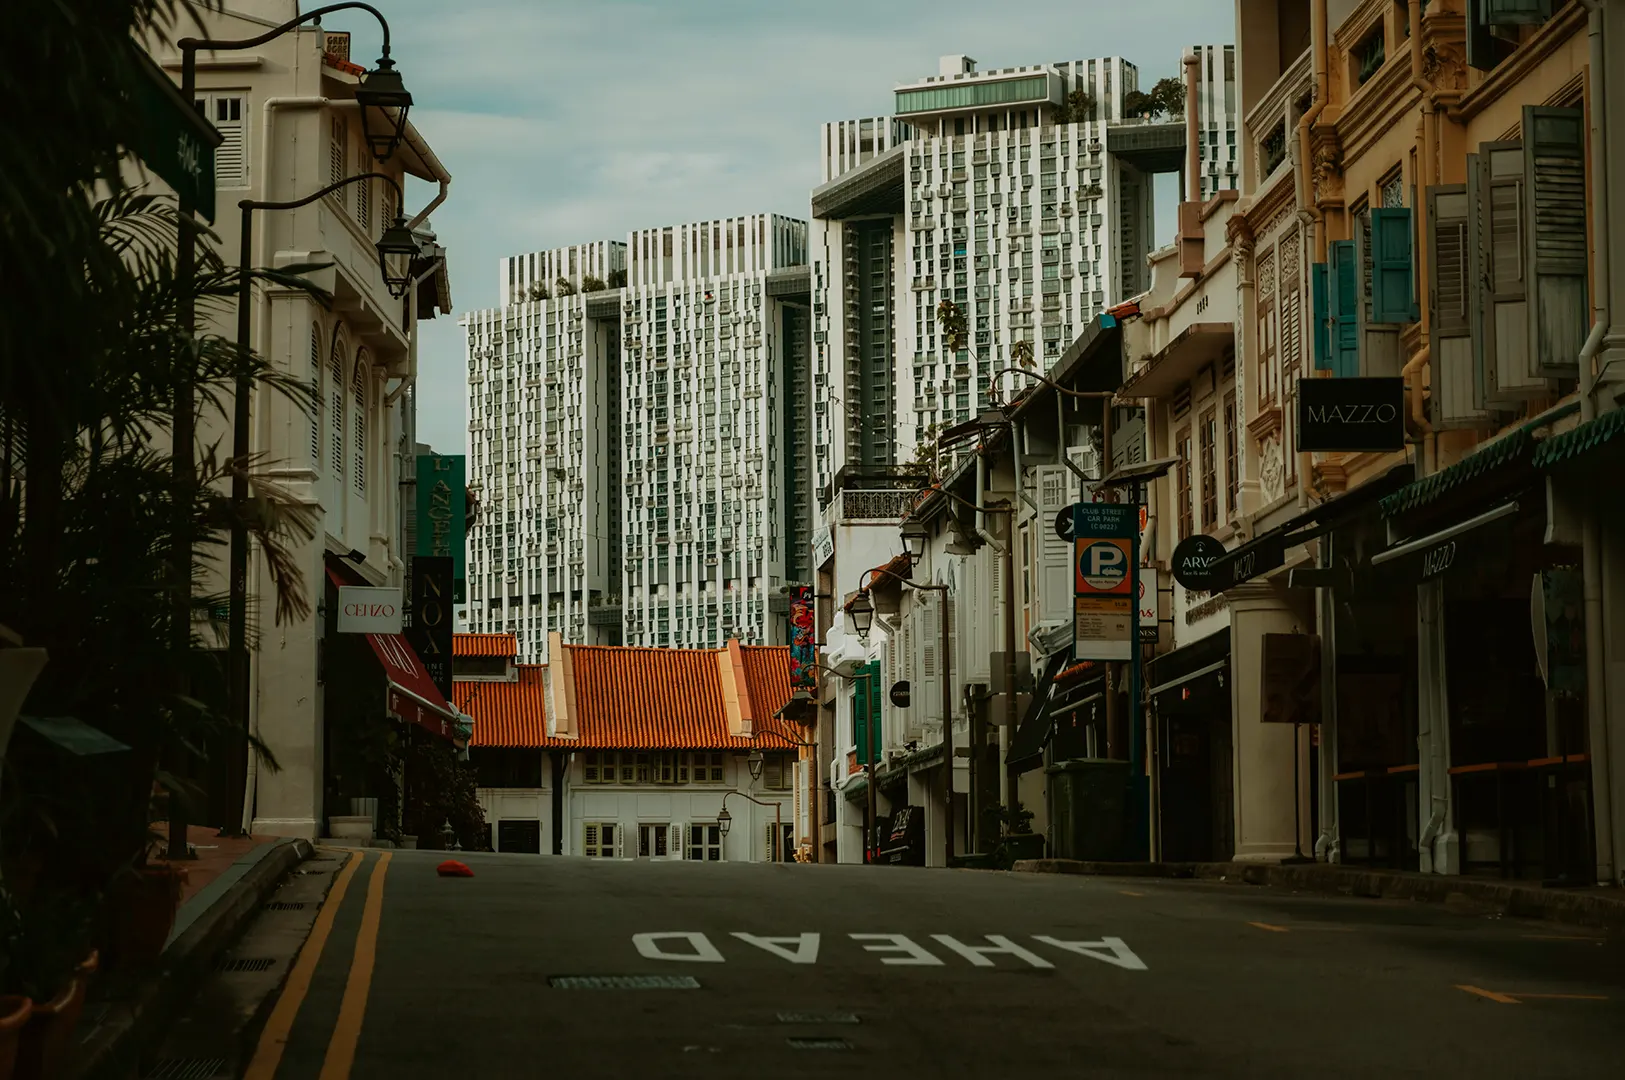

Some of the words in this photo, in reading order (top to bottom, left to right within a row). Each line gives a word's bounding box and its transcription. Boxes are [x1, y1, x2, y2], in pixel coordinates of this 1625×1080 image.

[1308, 403, 1396, 423] MAZZO
[1101, 508, 1127, 516] STREET
[1091, 546, 1123, 575] P
[632, 932, 1148, 970] AHEAD
